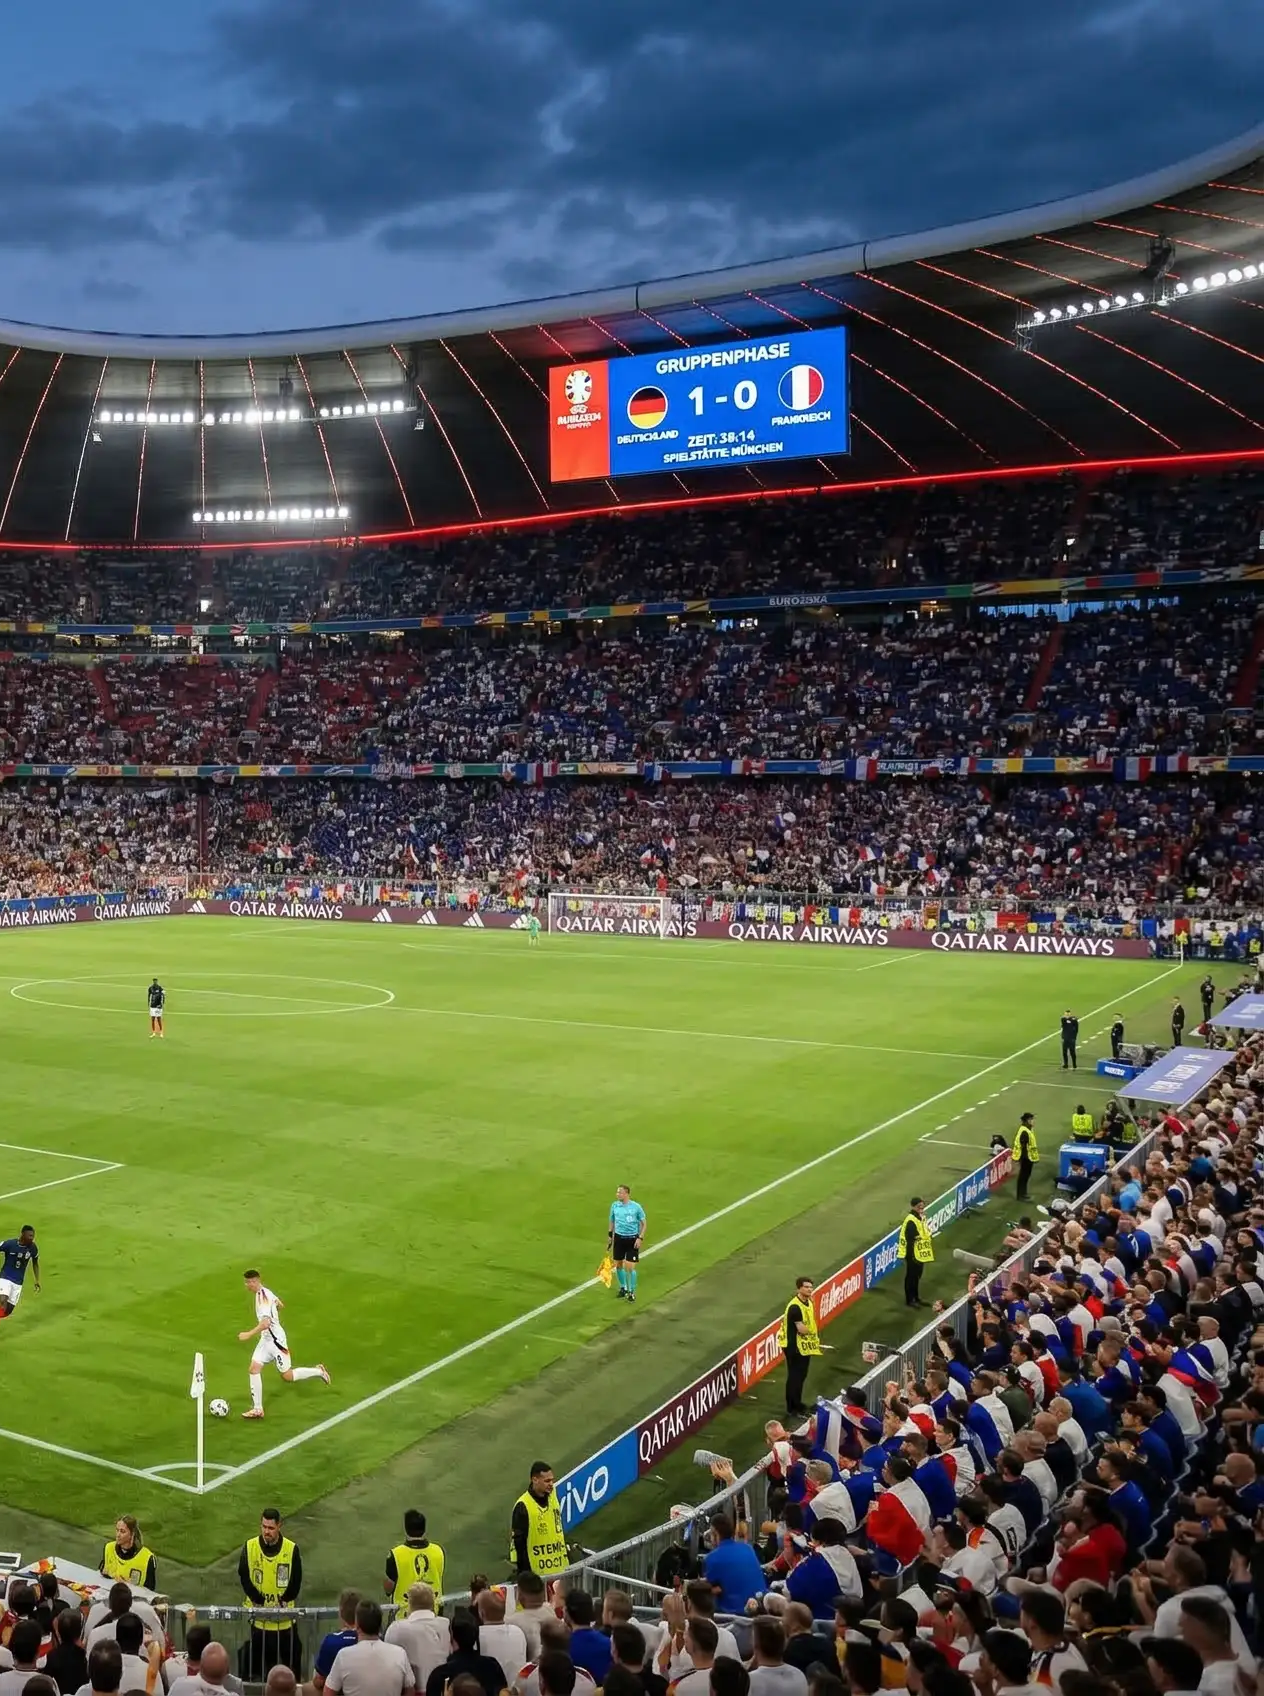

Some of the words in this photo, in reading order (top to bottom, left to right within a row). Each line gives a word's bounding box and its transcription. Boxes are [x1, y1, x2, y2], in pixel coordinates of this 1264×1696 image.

[656, 343, 790, 374] GRUPPENPHASE
[687, 433, 718, 447] ZEIT:
[731, 441, 783, 457] MÜNCHEN
[32, 907, 77, 925] AIRWAYS
[94, 904, 129, 921] QATAR
[229, 901, 277, 917] QATAR
[280, 903, 343, 919] AIRWAYS
[556, 916, 614, 934] QATAR
[622, 918, 696, 937] AIRWAYS
[728, 922, 794, 942] QATAR
[800, 924, 888, 946] AIRWAYS
[931, 931, 1008, 952] QATAR
[1013, 934, 1114, 956] AIRWAYS
[640, 1406, 684, 1464] QATAR
[688, 1365, 736, 1425] AIRWAYS
